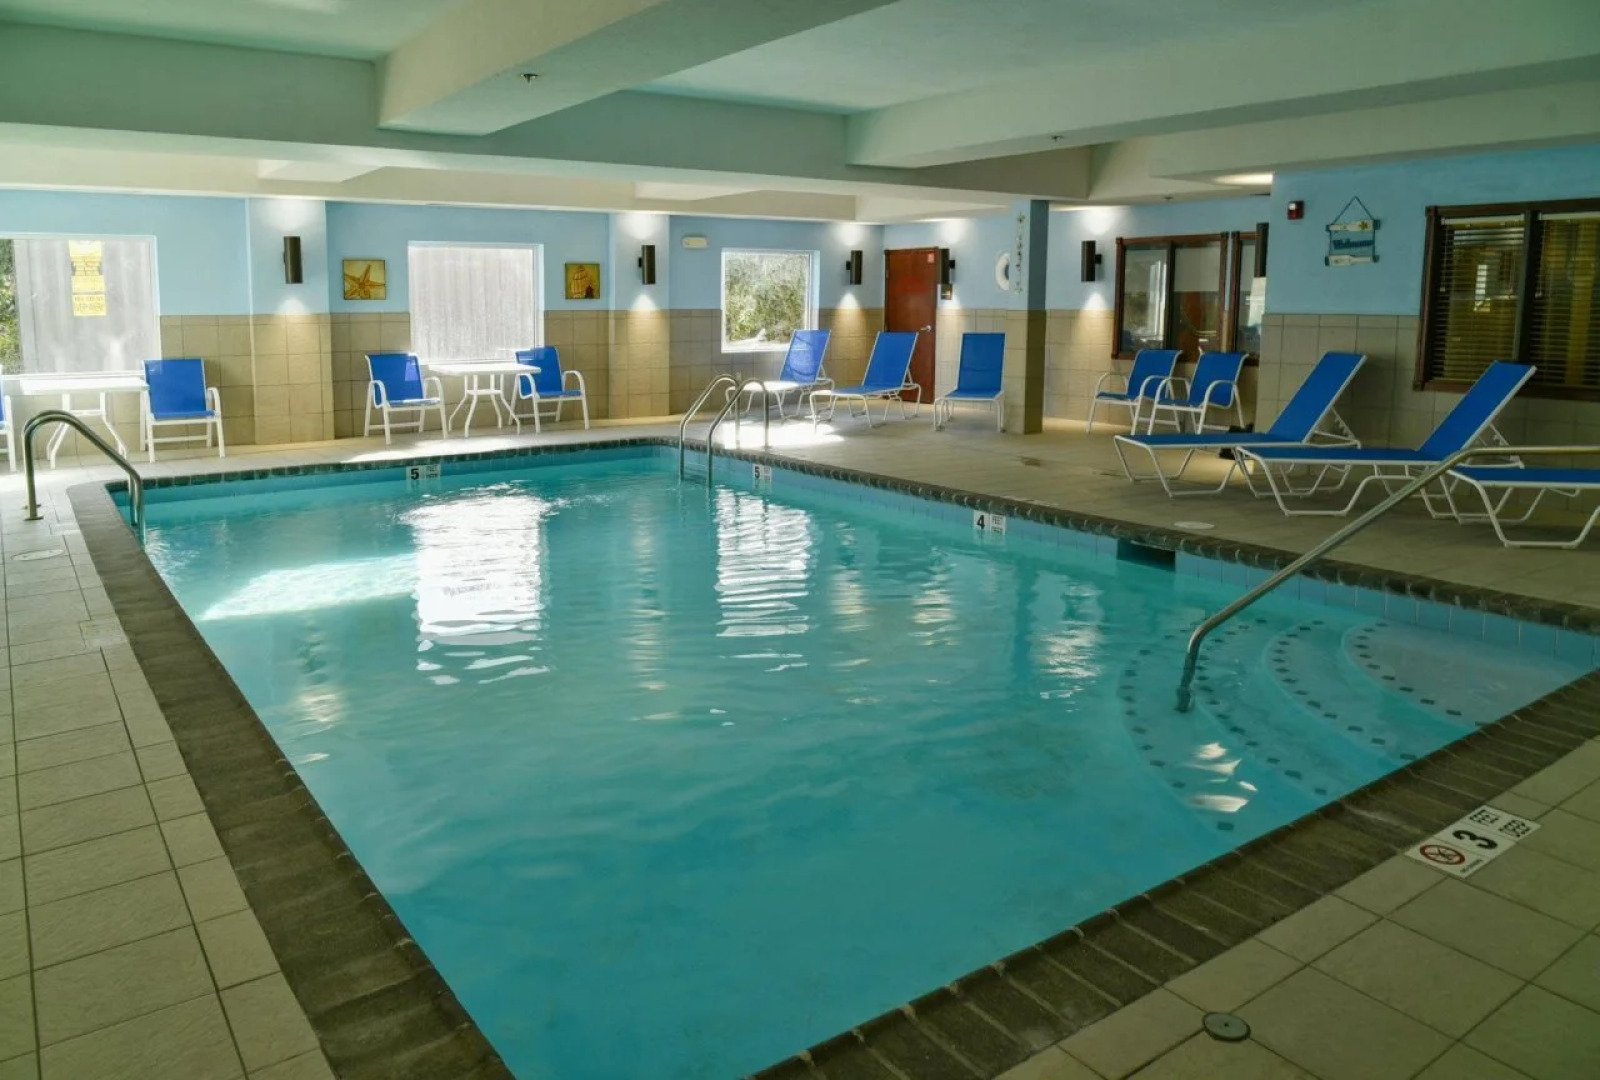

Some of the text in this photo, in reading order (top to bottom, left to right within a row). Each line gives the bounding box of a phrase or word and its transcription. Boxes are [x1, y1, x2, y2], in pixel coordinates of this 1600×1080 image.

[411, 468, 420, 480] 5
[754, 465, 760, 478] 5
[977, 514, 985, 530] 4
[1469, 809, 1499, 826] FEET
[1498, 819, 1531, 838] DEEP
[1452, 830, 1498, 849] 3
